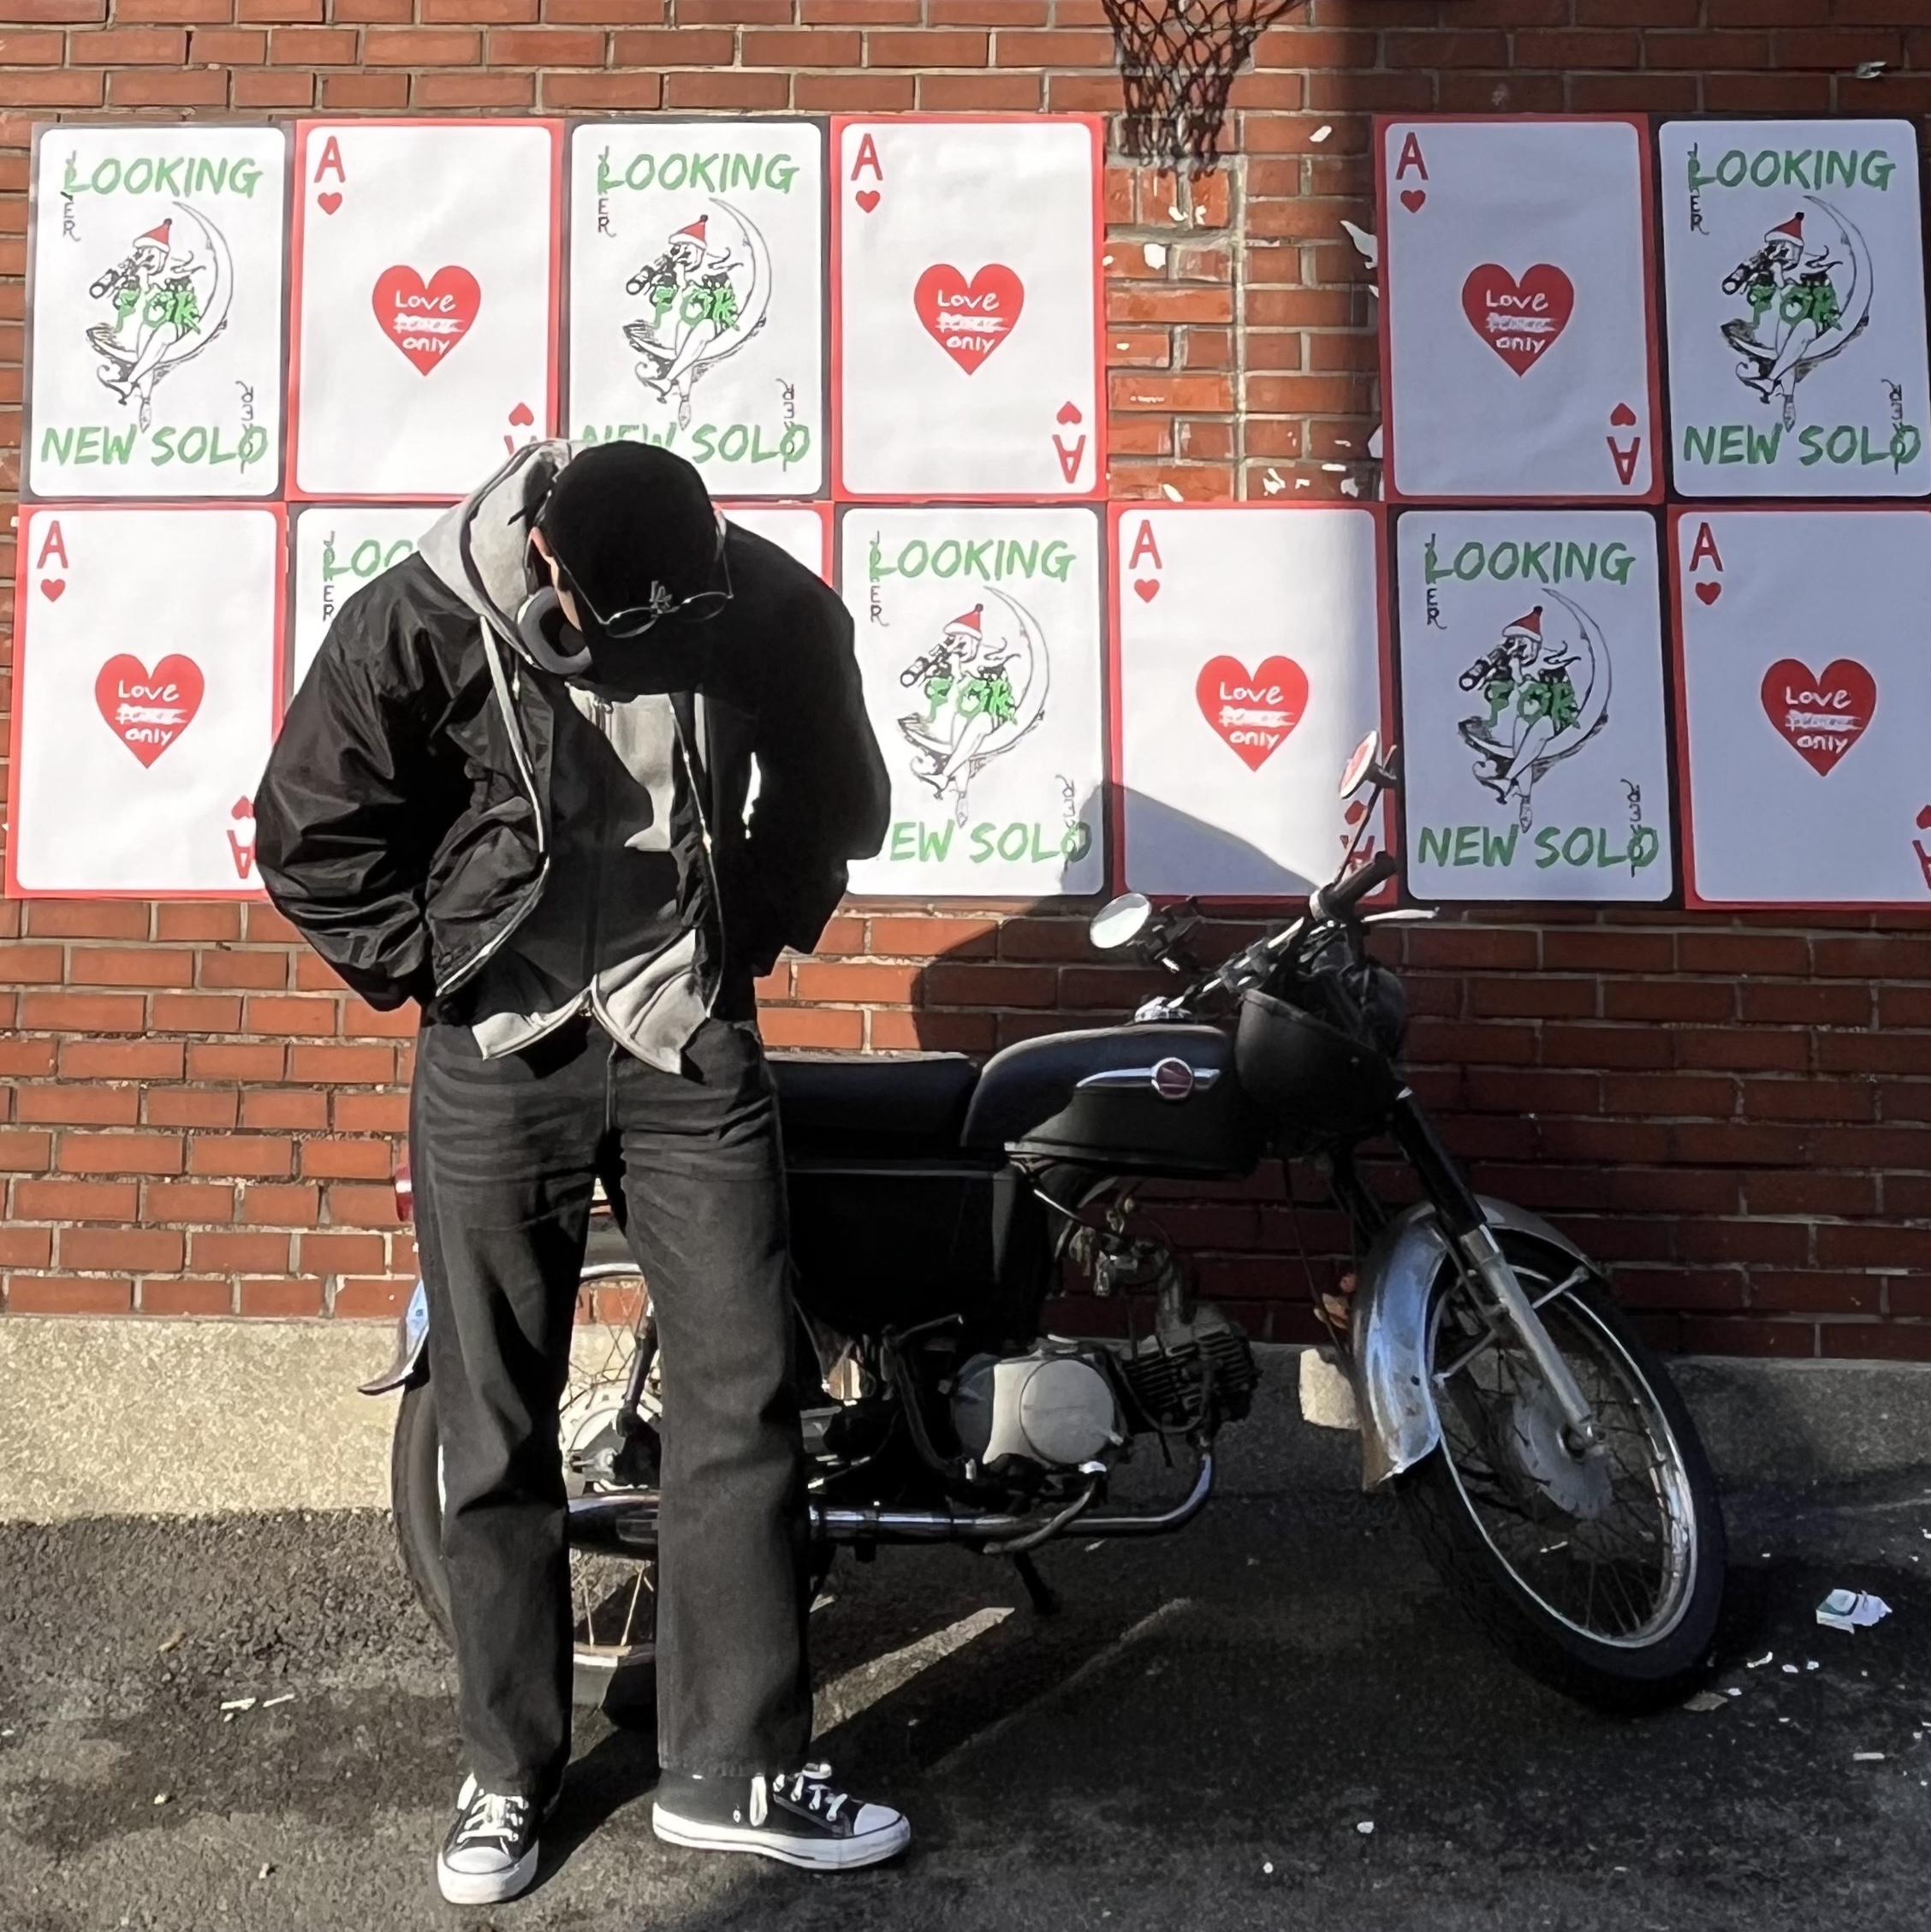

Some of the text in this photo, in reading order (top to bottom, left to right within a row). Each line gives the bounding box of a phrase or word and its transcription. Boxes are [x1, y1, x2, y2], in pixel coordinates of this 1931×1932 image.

[64, 156, 264, 198] LOOKING
[314, 134, 346, 183] A
[597, 152, 799, 194] LOOKING
[851, 133, 884, 181] A
[1395, 131, 1429, 181] A
[1688, 149, 1897, 191] LOOKING
[395, 290, 456, 312] Love
[937, 289, 1000, 312] Love
[1486, 289, 1549, 312] Love
[402, 336, 451, 355] only
[946, 333, 995, 356] only
[1495, 334, 1547, 355] only
[40, 425, 269, 467] NEW SOLO
[692, 424, 811, 464] SOLO
[1052, 435, 1086, 484] A
[1607, 437, 1641, 485] A
[1684, 422, 1921, 467] NEW SOLO
[37, 520, 68, 569] A
[869, 539, 1077, 582] LOOKING
[1129, 520, 1162, 569] A
[1424, 542, 1636, 585] LOOKING
[1690, 521, 1723, 572] A
[118, 679, 180, 703] Love
[1220, 680, 1284, 704] Love
[1785, 686, 1852, 710] Love
[125, 727, 175, 748] only
[1229, 730, 1280, 752] only
[1797, 734, 1850, 755] only
[227, 830, 254, 880] A
[890, 821, 1092, 864] EW SOLO
[1417, 823, 1520, 868] NEW
[1533, 825, 1660, 869] SOLO
